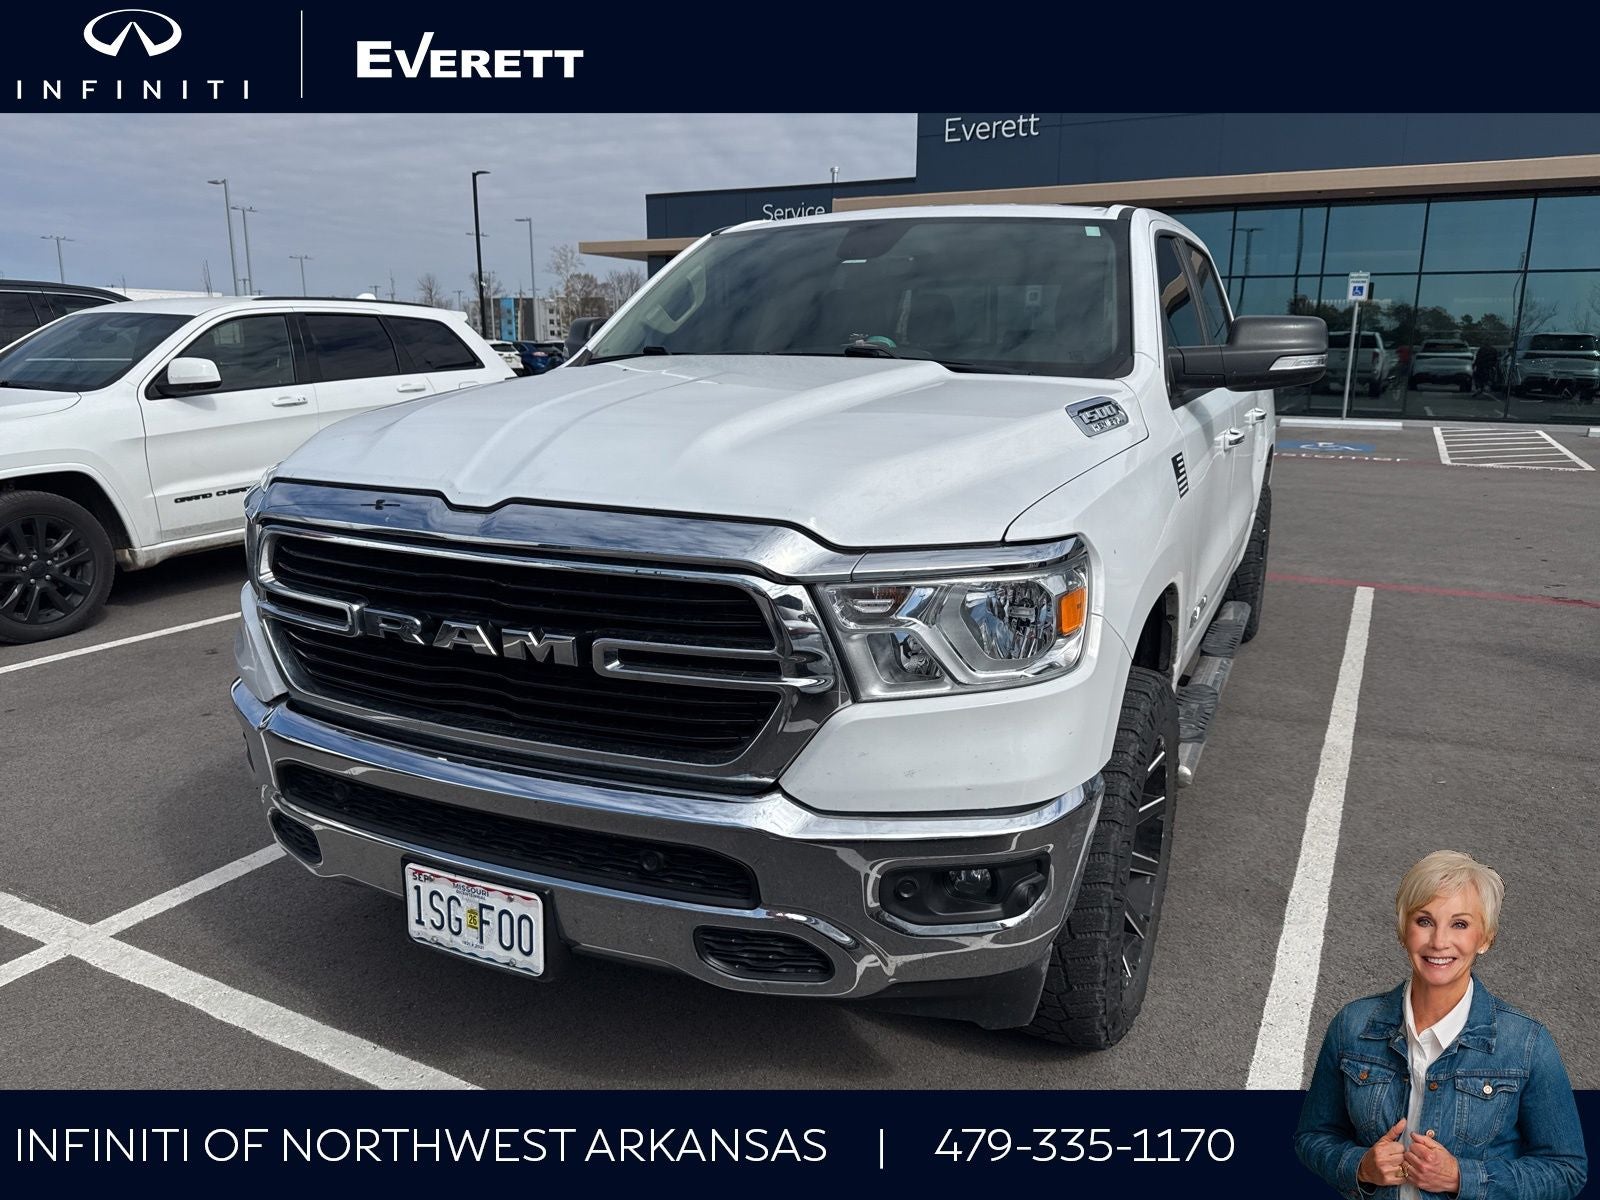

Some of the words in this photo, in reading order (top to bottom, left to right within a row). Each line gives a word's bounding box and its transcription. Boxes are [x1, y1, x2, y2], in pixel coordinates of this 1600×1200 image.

[944, 113, 1040, 143] Everett
[762, 202, 825, 221] Service
[1079, 404, 1117, 424] 1500
[174, 492, 213, 504] GRAND
[364, 607, 578, 667] RAM
[452, 882, 490, 898] MISSOURI
[413, 884, 463, 936] 1SG
[468, 914, 478, 926] 26
